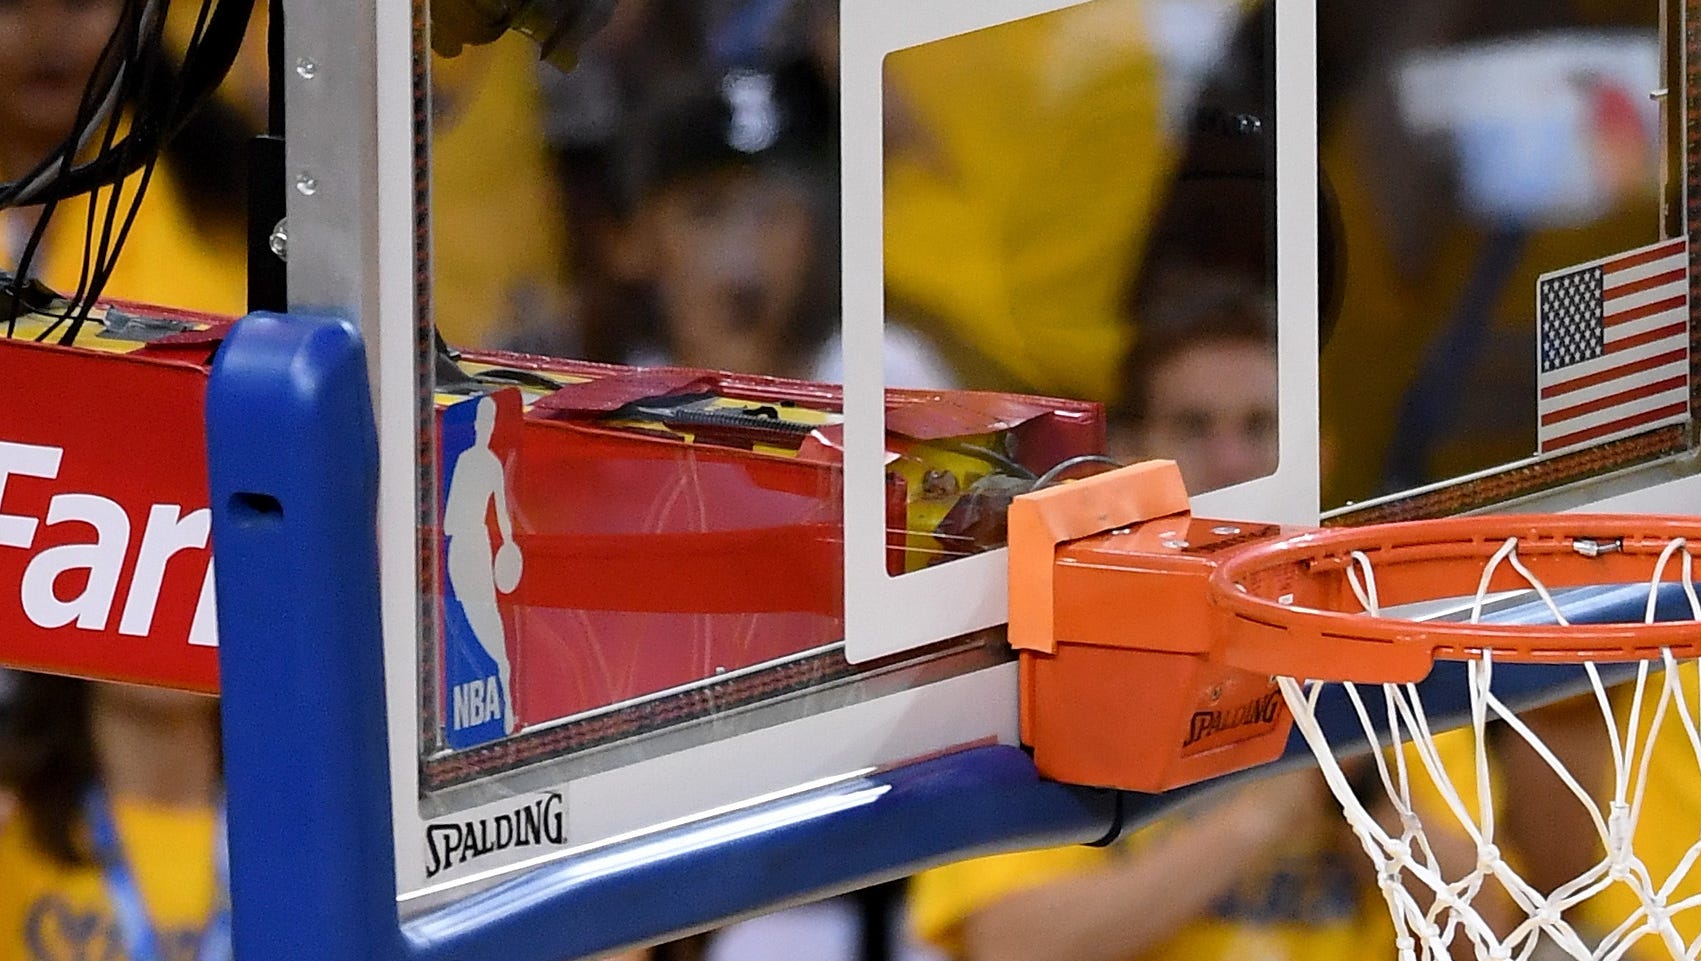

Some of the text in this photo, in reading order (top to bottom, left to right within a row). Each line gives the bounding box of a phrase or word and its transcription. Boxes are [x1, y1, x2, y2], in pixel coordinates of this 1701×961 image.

[0, 440, 220, 648] Far
[453, 675, 501, 731] NBA
[1182, 687, 1281, 748] SPALDING
[425, 792, 564, 879] SPALDING
